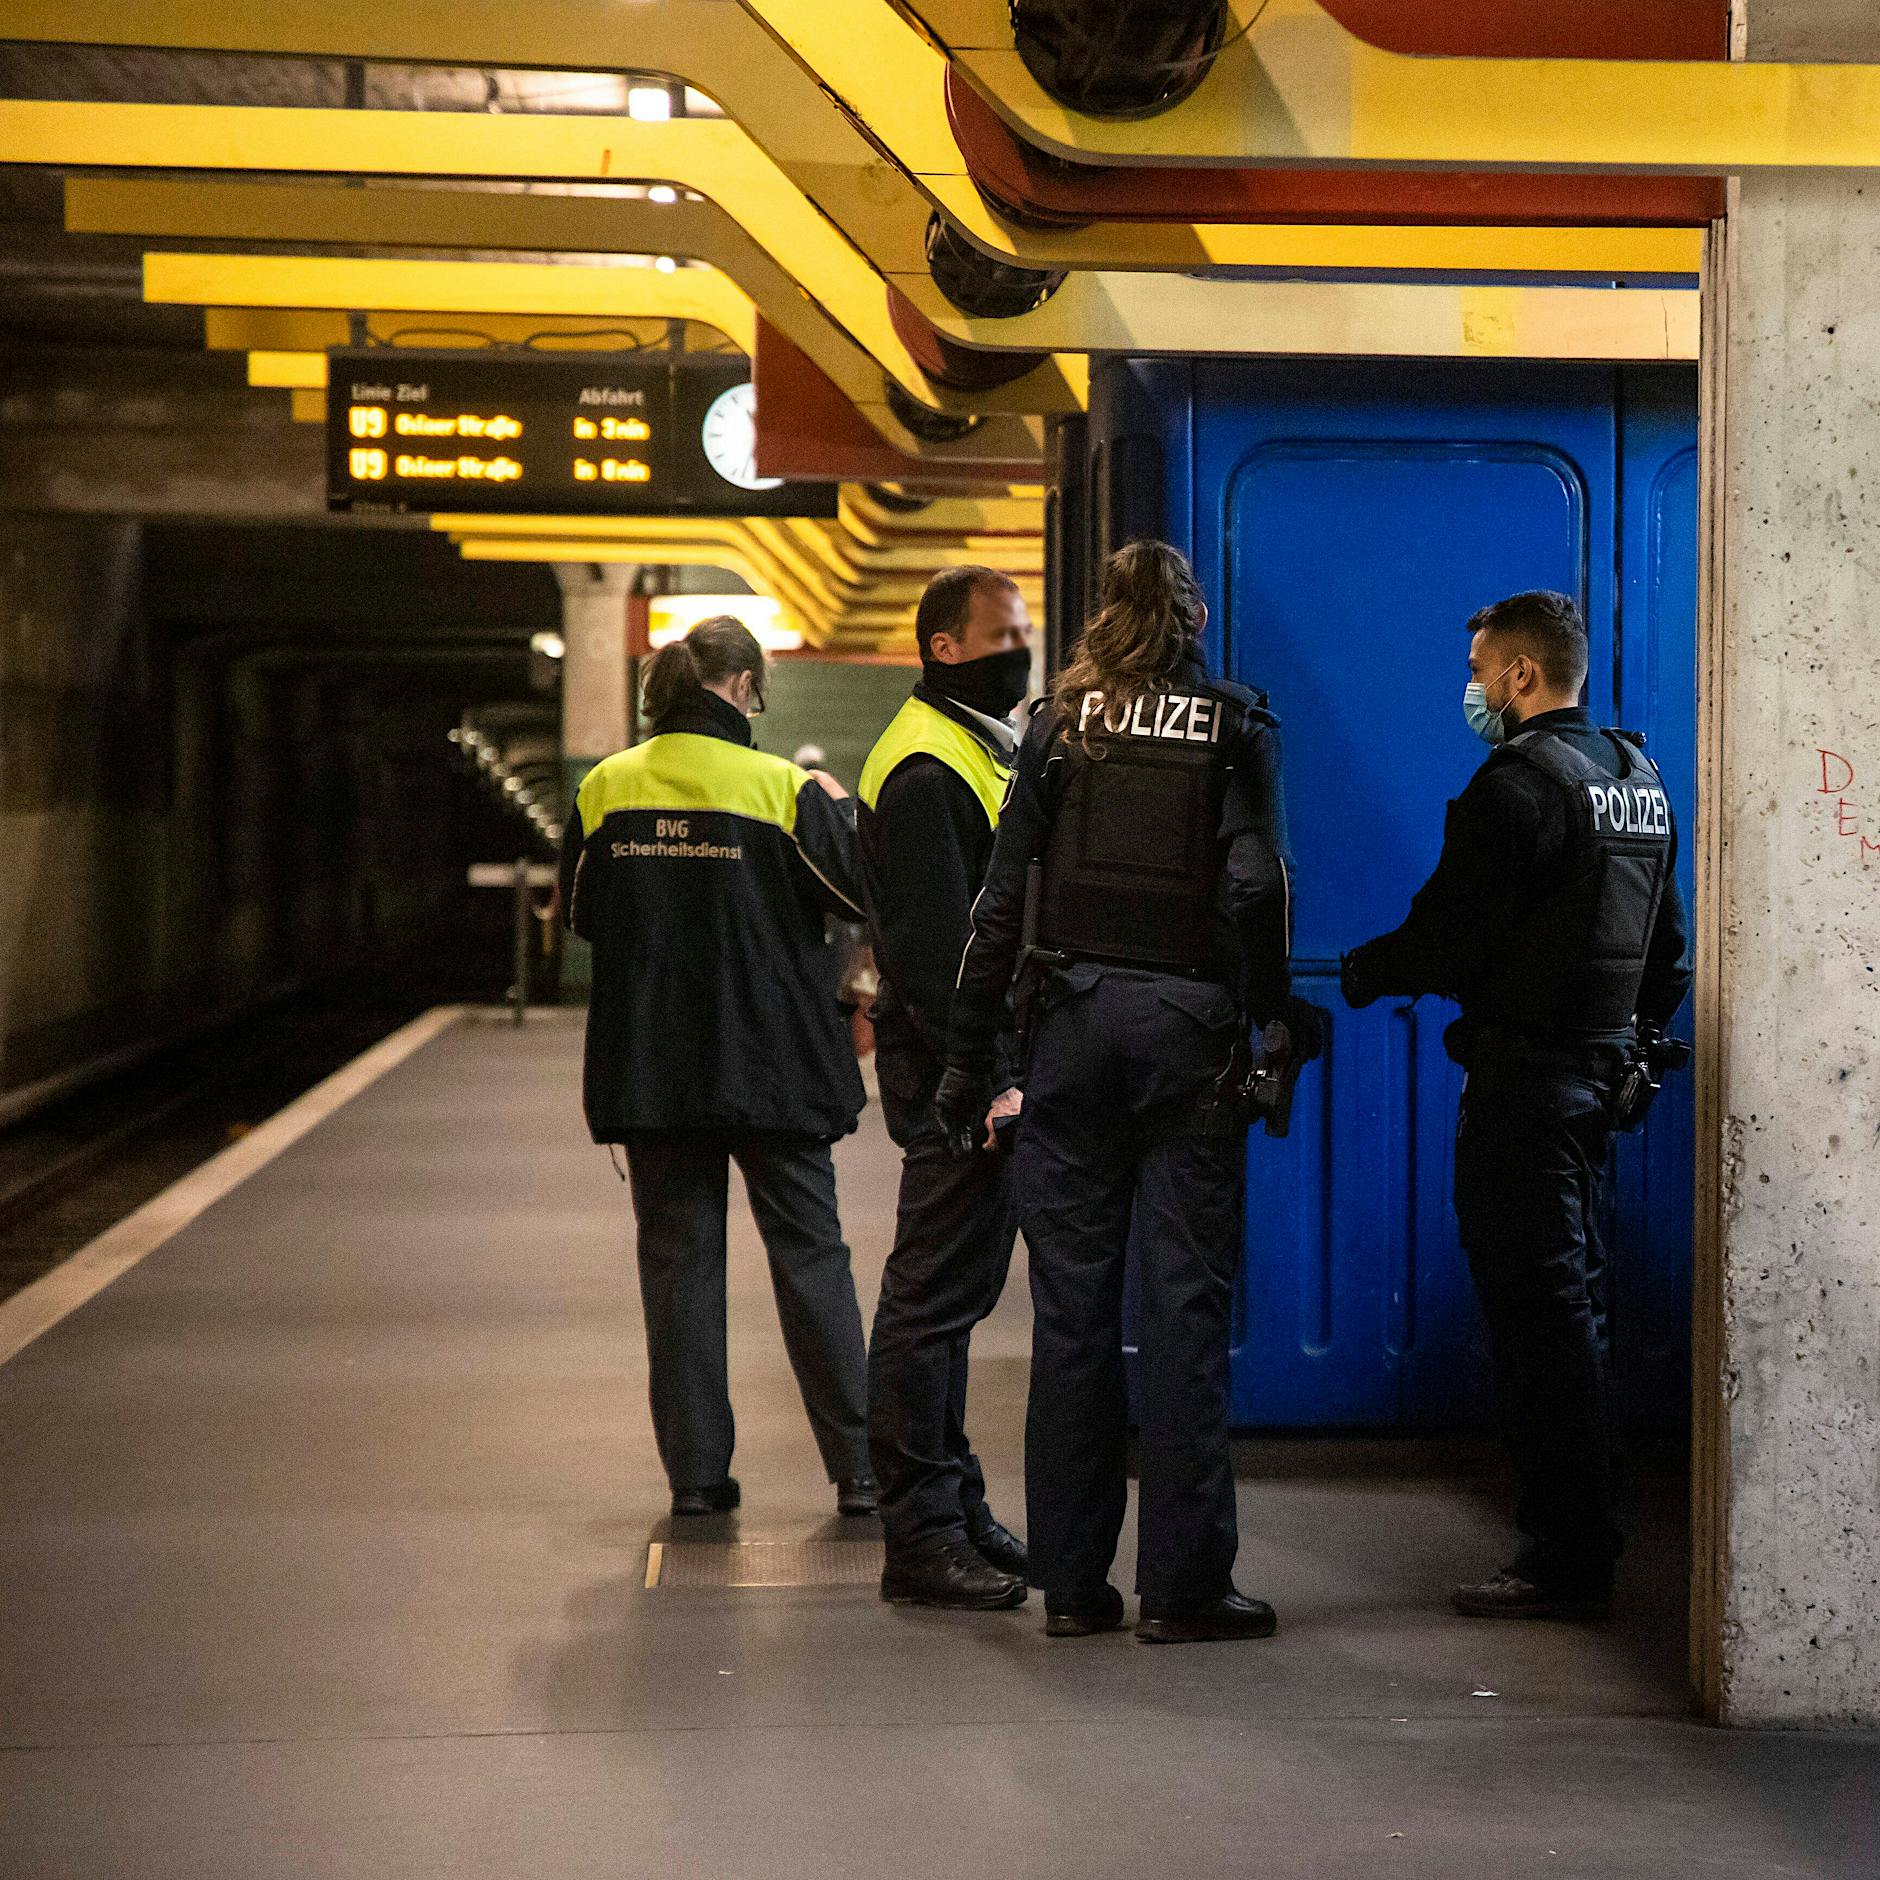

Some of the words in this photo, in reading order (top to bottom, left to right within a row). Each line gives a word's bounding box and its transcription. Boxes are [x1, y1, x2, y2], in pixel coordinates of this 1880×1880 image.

[579, 387, 644, 406] Abfahrt
[350, 406, 387, 438] U9
[350, 448, 387, 480] U9
[1078, 690, 1222, 743] POLIZEI
[1588, 785, 1670, 835] POLIZEI
[656, 819, 690, 838] BVG
[610, 841, 742, 860] Sicherheitsdienst
